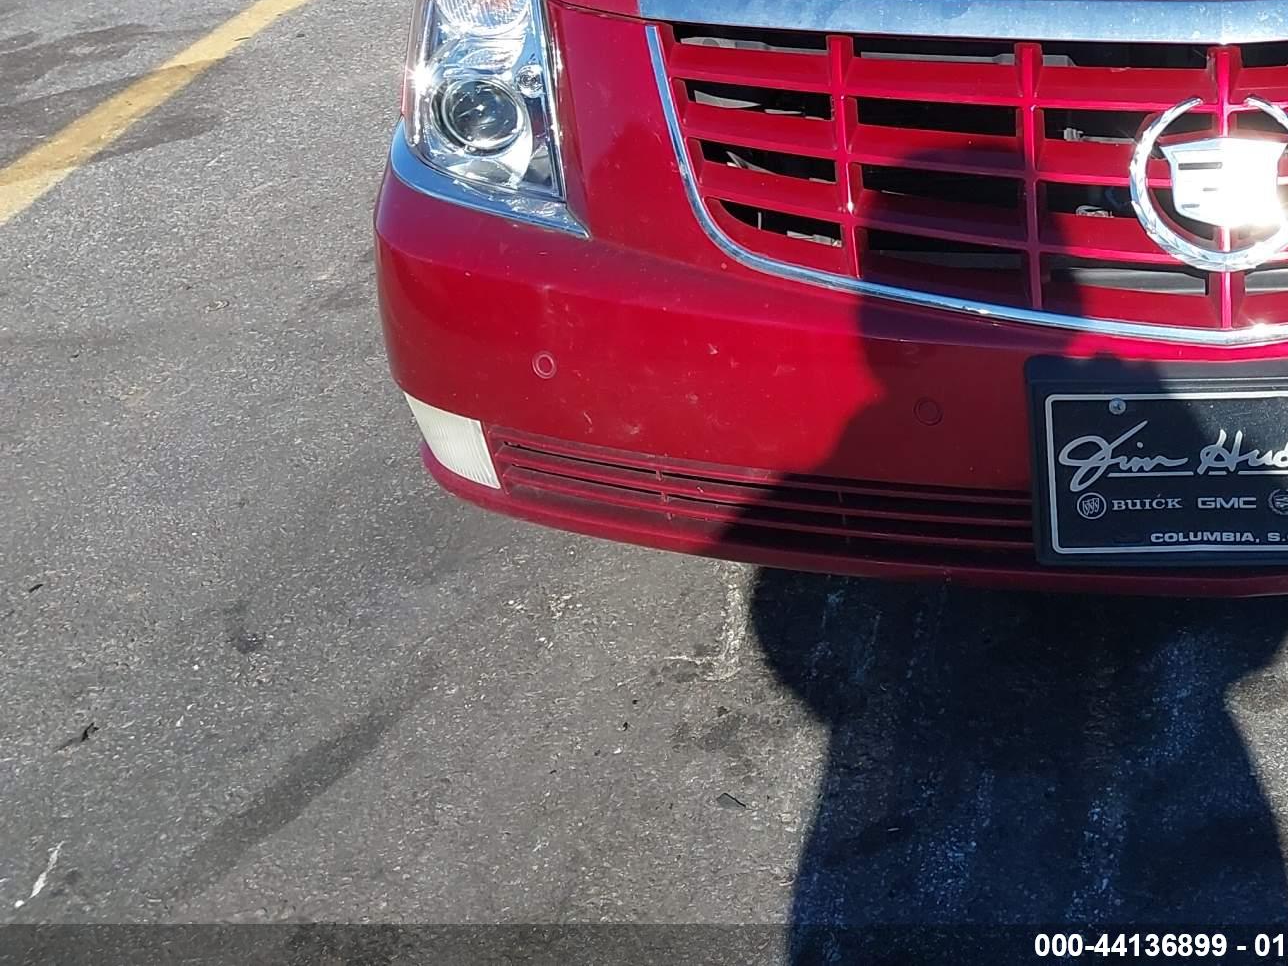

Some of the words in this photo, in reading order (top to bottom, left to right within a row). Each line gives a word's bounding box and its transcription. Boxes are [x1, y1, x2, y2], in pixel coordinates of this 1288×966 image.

[1058, 420, 1188, 492] Jim
[1112, 496, 1183, 511] BUICK
[1197, 496, 1257, 509] GMC
[1150, 531, 1260, 544] COLUMBIA,
